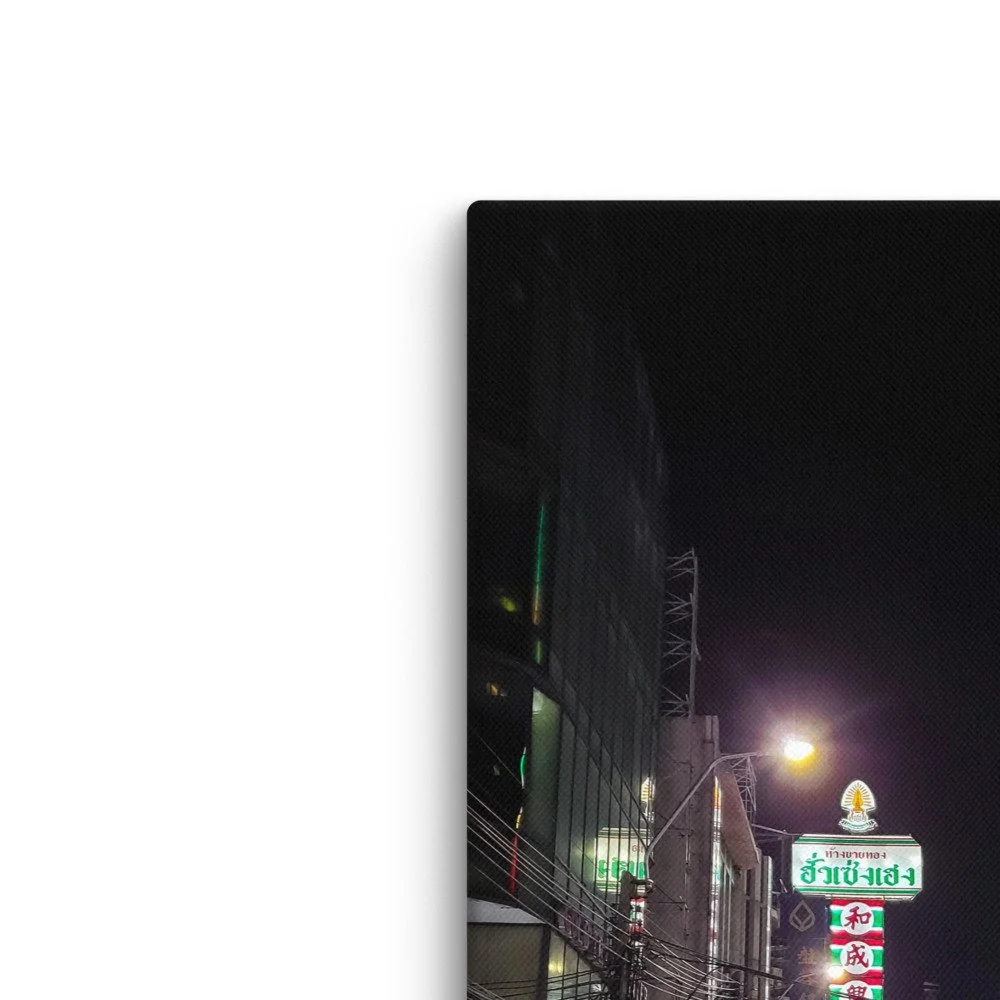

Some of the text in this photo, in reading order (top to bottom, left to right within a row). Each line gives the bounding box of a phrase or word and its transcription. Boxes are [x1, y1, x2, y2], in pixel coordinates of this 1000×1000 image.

[825, 847, 887, 860] ห้างขายทอง
[800, 852, 915, 887] ฮั่วเซ่งเฮง
